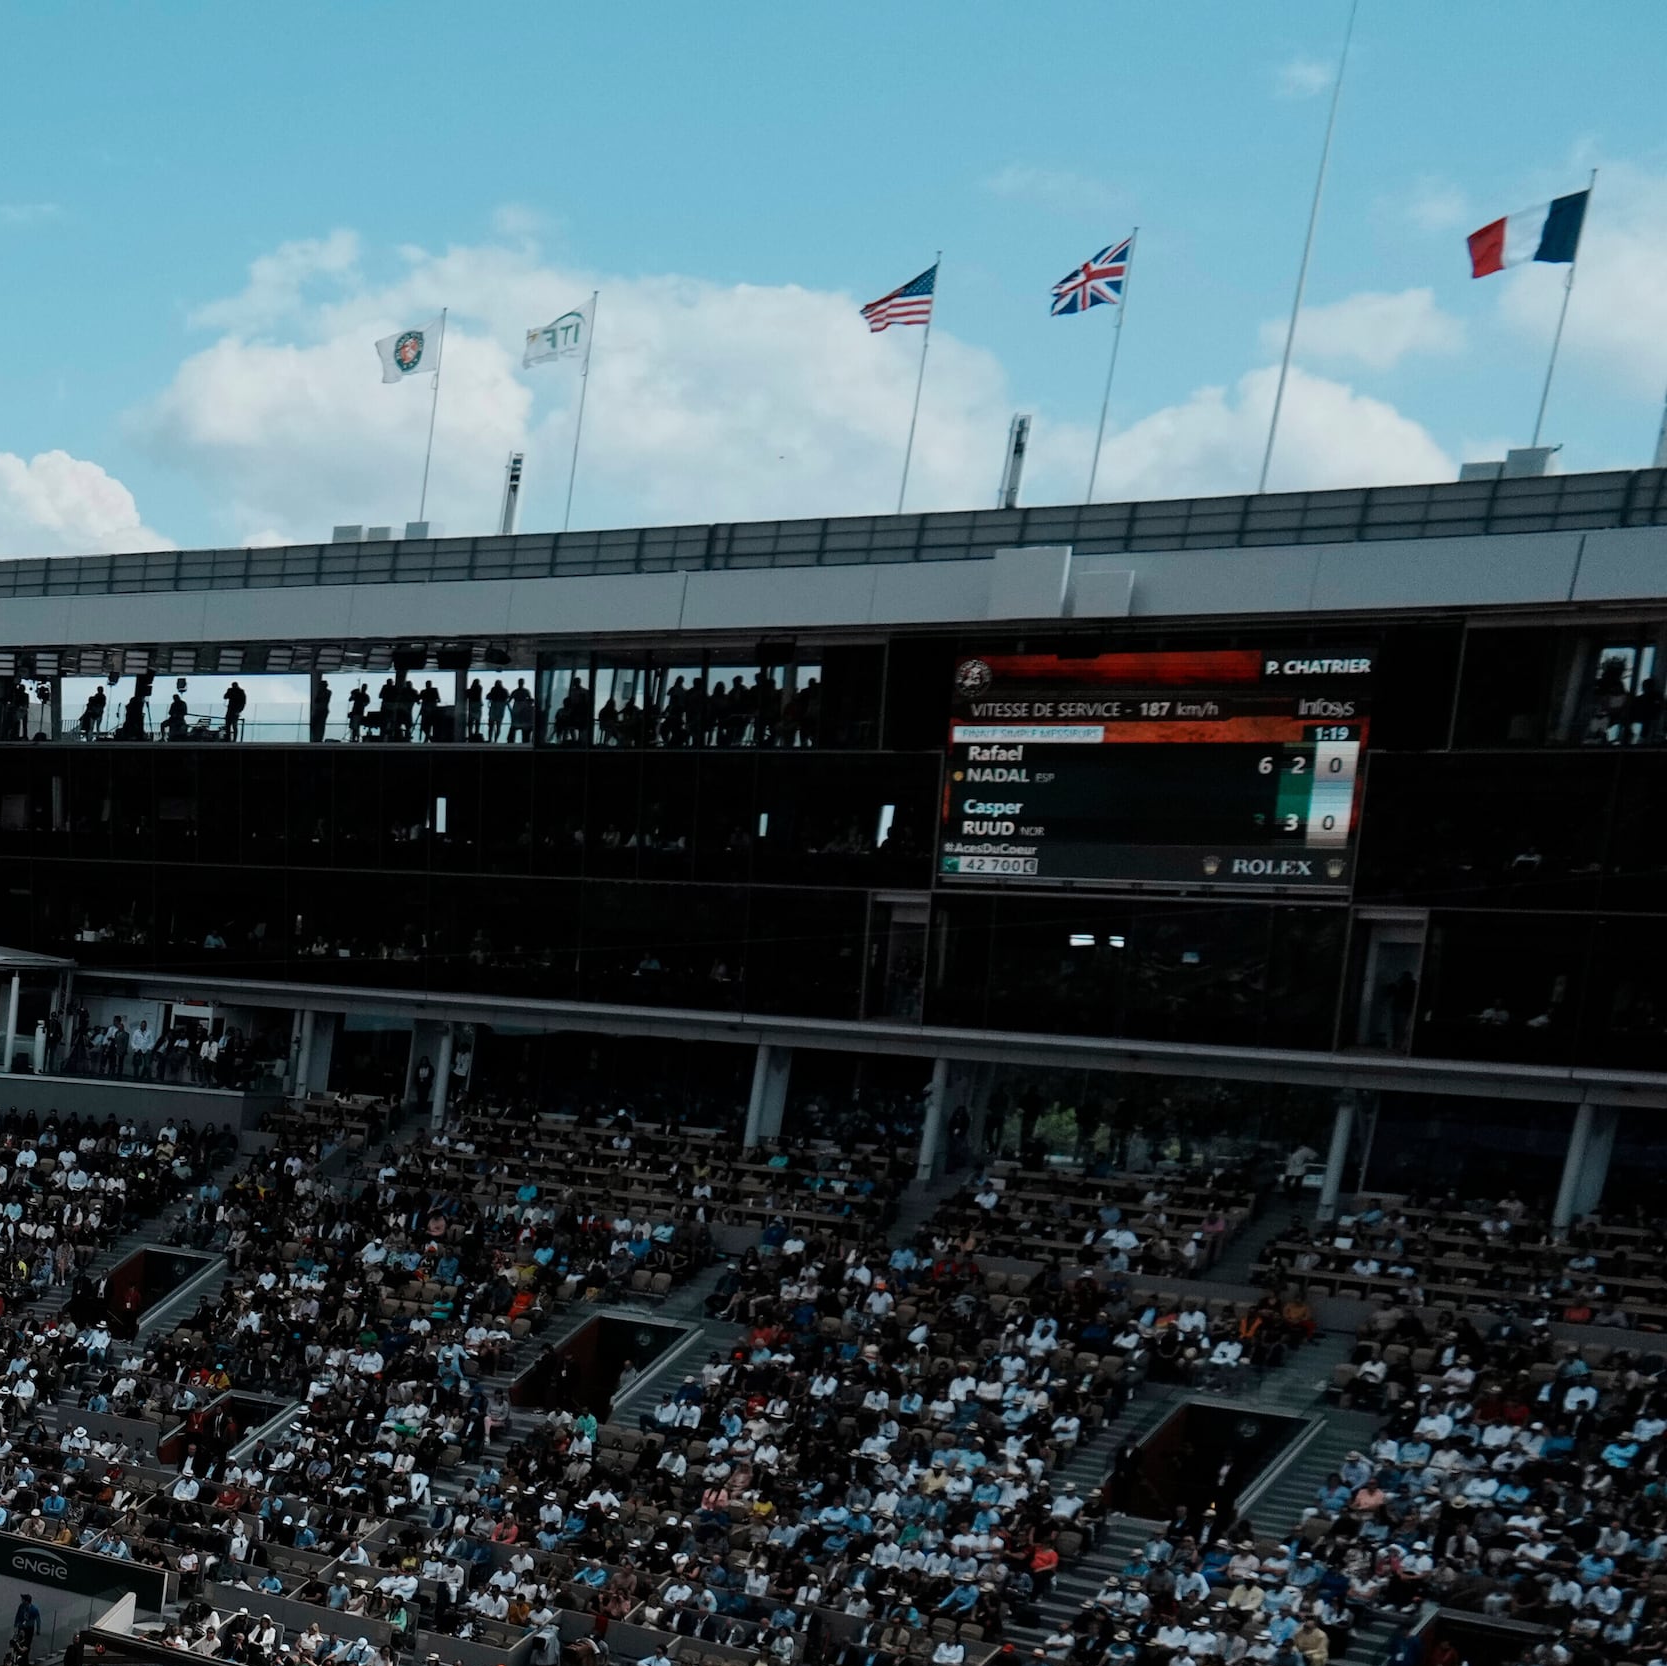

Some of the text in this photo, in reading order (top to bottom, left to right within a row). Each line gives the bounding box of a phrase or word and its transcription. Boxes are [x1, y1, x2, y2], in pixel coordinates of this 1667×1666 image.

[1265, 658, 1371, 675] P. CHATRIER
[970, 702, 1029, 717] VITESSE
[1033, 702, 1055, 717] DE
[1057, 702, 1121, 717] SERVICE
[1139, 701, 1169, 717] 187
[1174, 701, 1219, 717] km/h
[1314, 726, 1350, 740] 1:19
[968, 744, 1024, 761] Rafael
[1258, 756, 1342, 774] 6 2 0
[966, 767, 1056, 783] NADAL ESP
[963, 798, 1024, 818] Casper
[962, 820, 1016, 836] RUUD
[1283, 813, 1300, 832] 3
[1323, 815, 1335, 830] 0
[966, 859, 986, 871] 42
[993, 859, 1021, 872] 700
[1231, 858, 1313, 876] ROLEX
